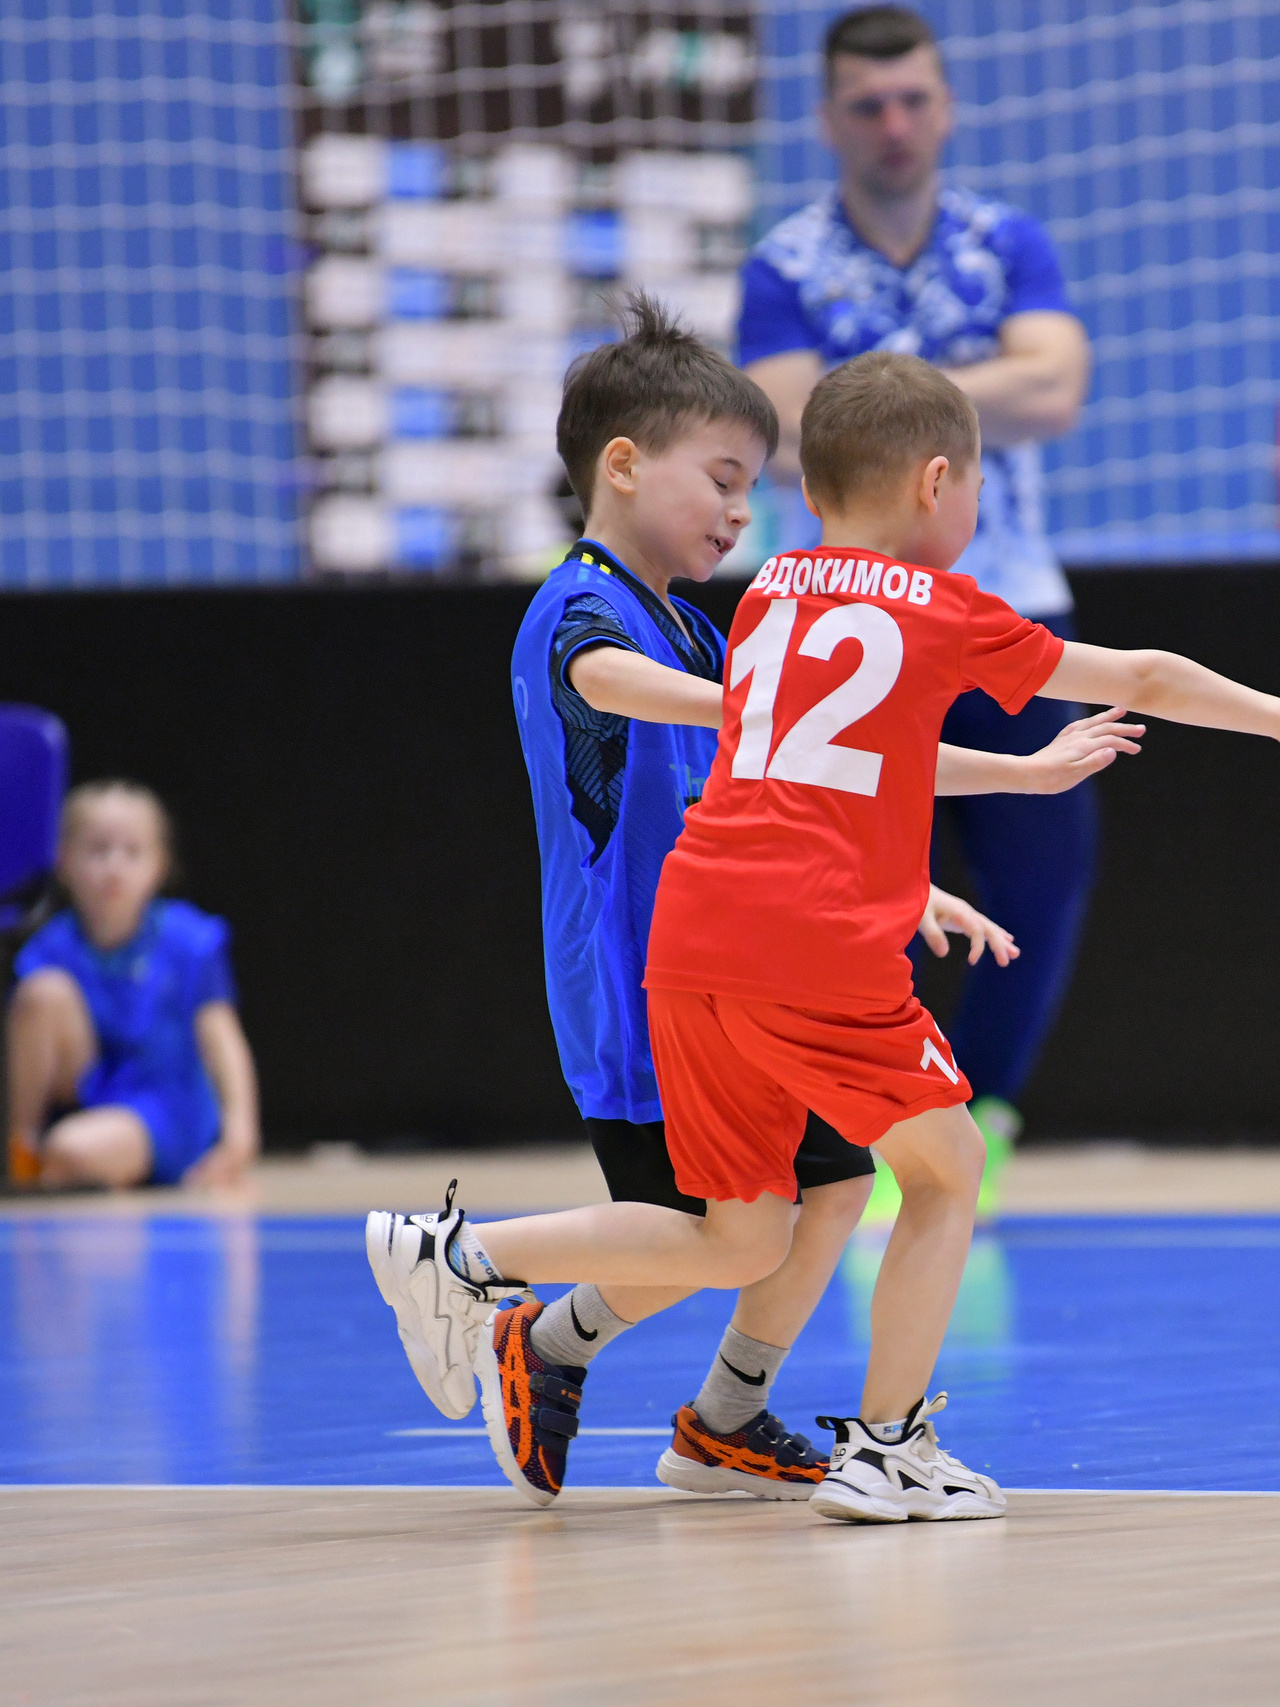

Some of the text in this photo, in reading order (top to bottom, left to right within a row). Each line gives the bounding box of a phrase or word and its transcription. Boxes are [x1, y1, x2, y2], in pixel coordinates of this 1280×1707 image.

[746, 557, 934, 606] ВДОКИМОВ
[730, 598, 904, 798] 12
[920, 1021, 960, 1086] 1
